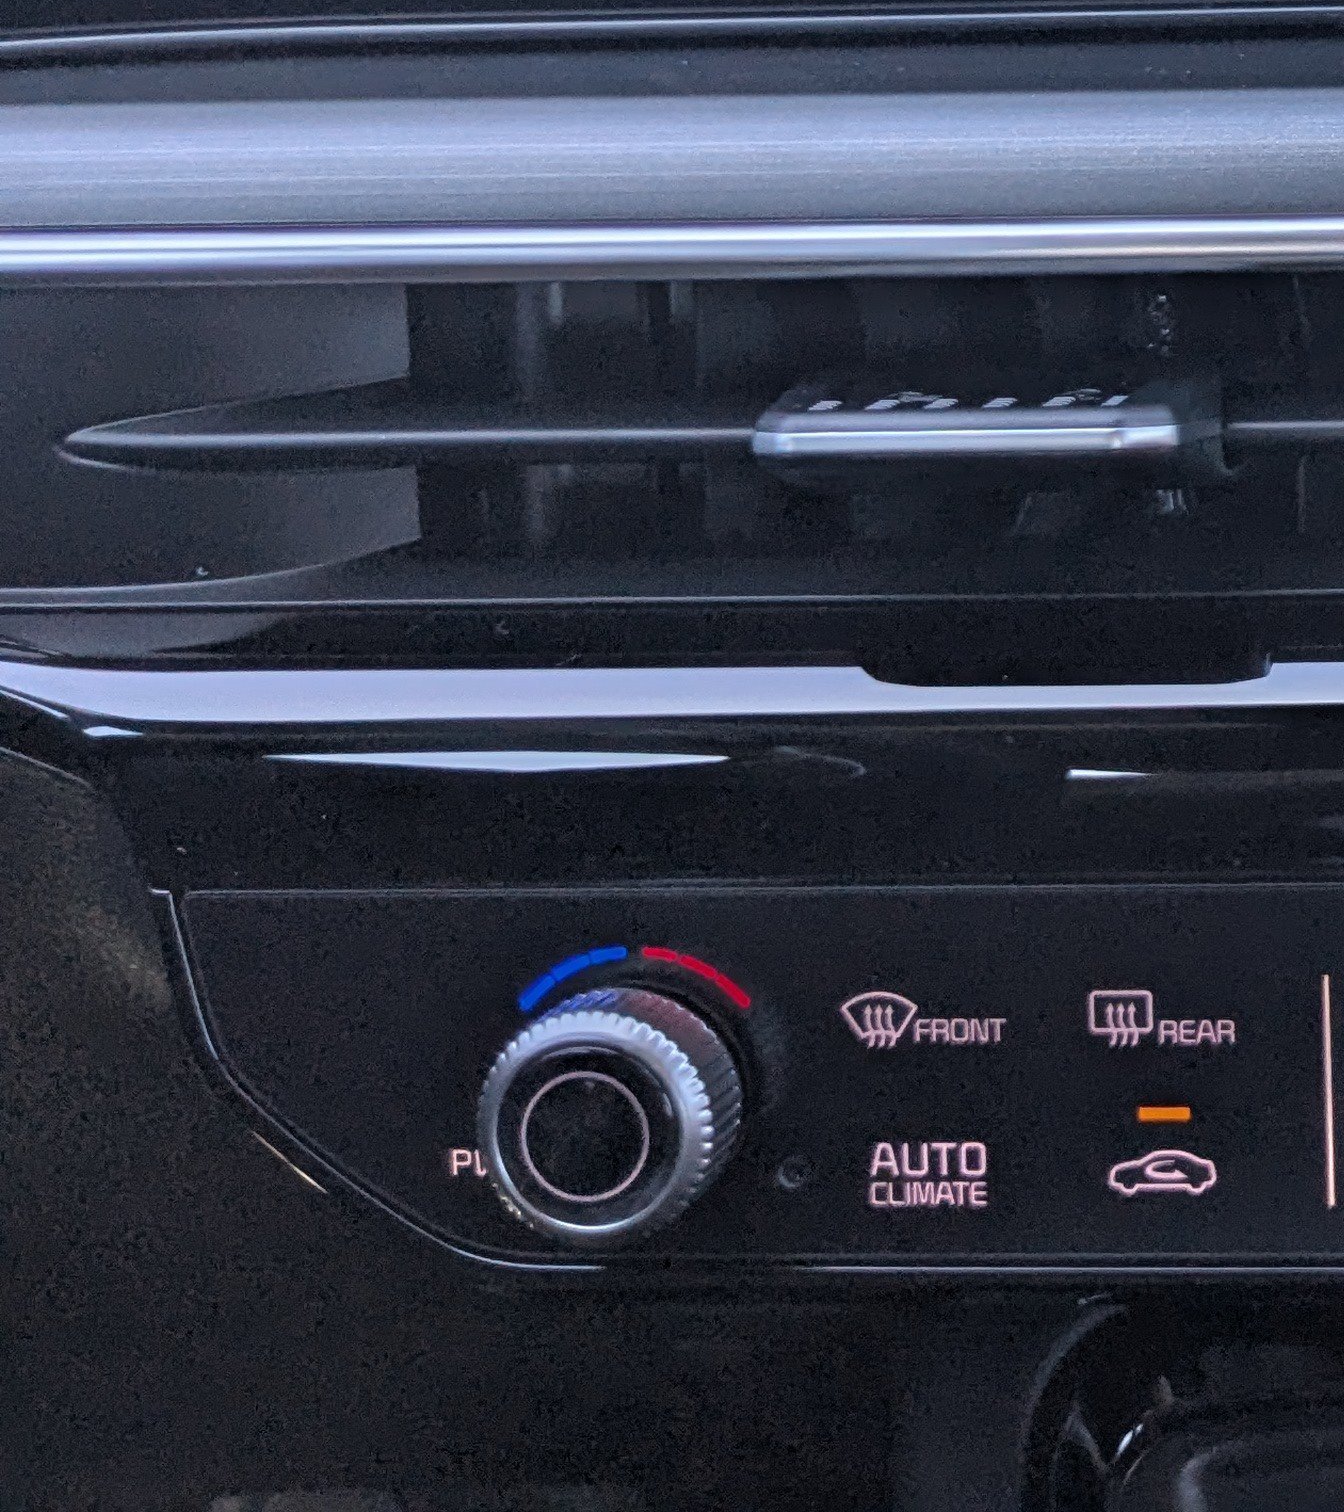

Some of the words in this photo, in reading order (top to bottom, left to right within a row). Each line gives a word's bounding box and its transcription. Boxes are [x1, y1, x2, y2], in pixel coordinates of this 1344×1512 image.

[912, 1017, 1007, 1045] FRONT
[1157, 1019, 1236, 1046] REAR
[869, 1141, 988, 1178] AUTO
[869, 1180, 989, 1208] CLIMATE
